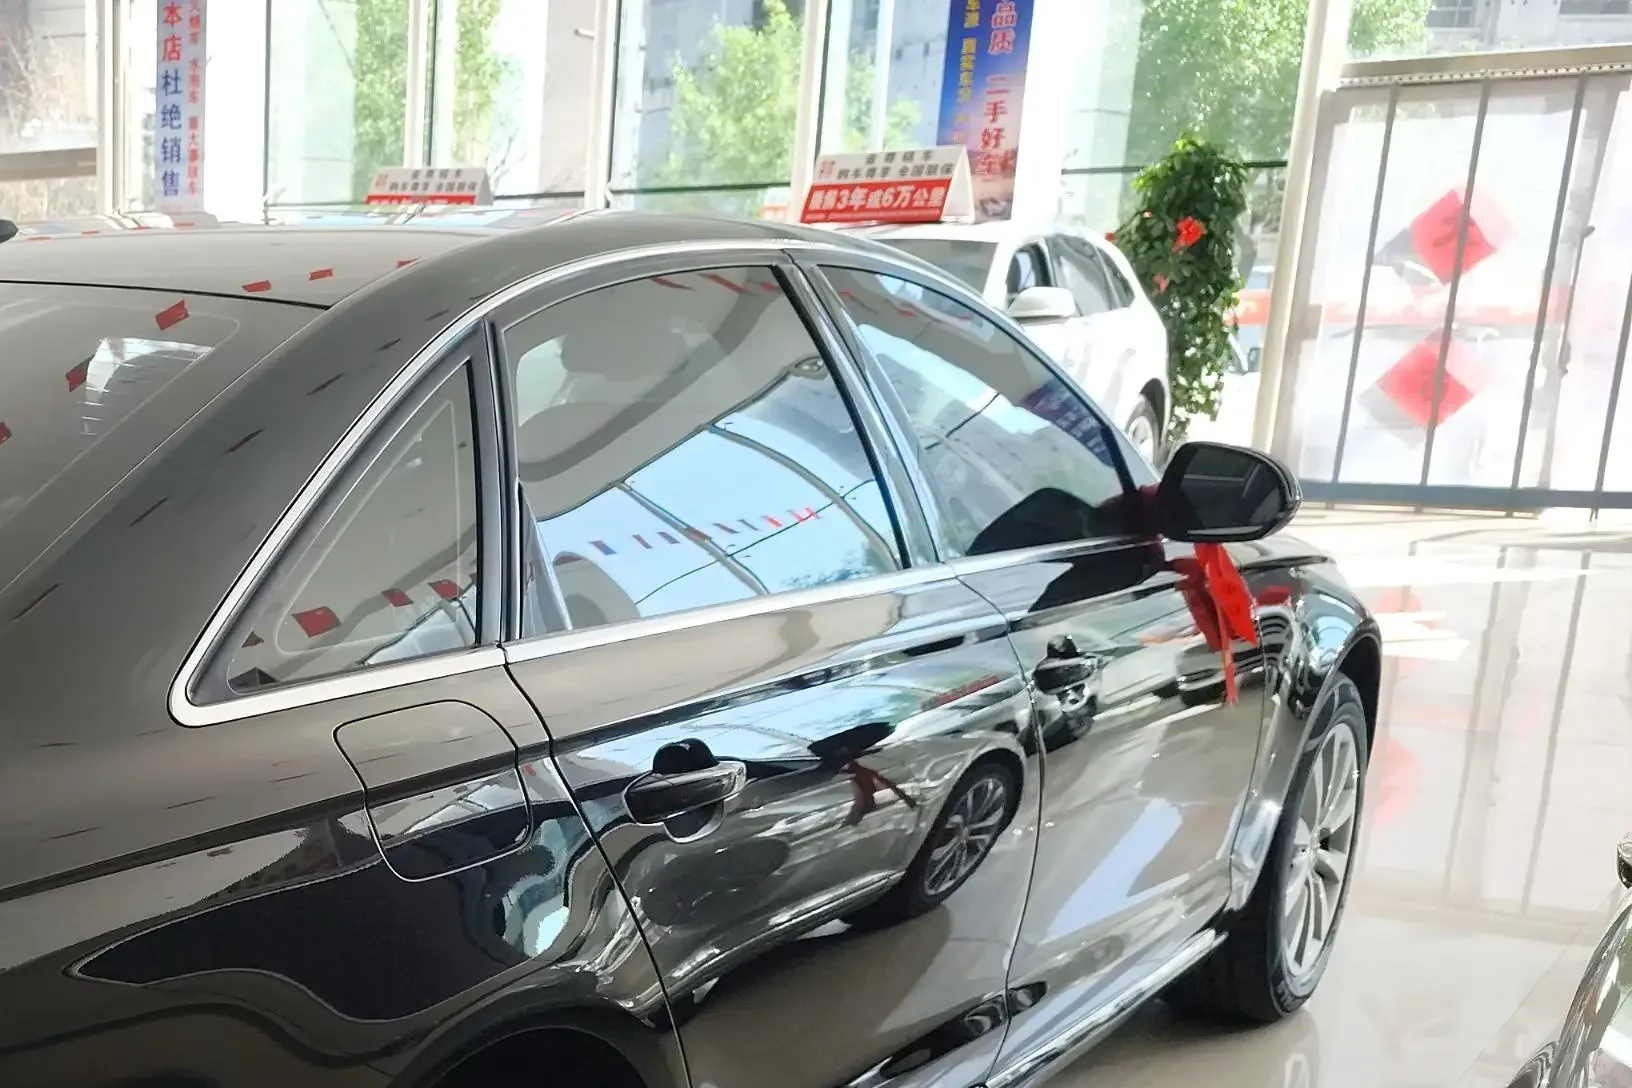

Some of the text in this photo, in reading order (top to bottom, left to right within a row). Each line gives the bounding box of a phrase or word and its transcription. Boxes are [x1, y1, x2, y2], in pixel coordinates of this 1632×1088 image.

[161, 2, 184, 197] 本店杜绝销售
